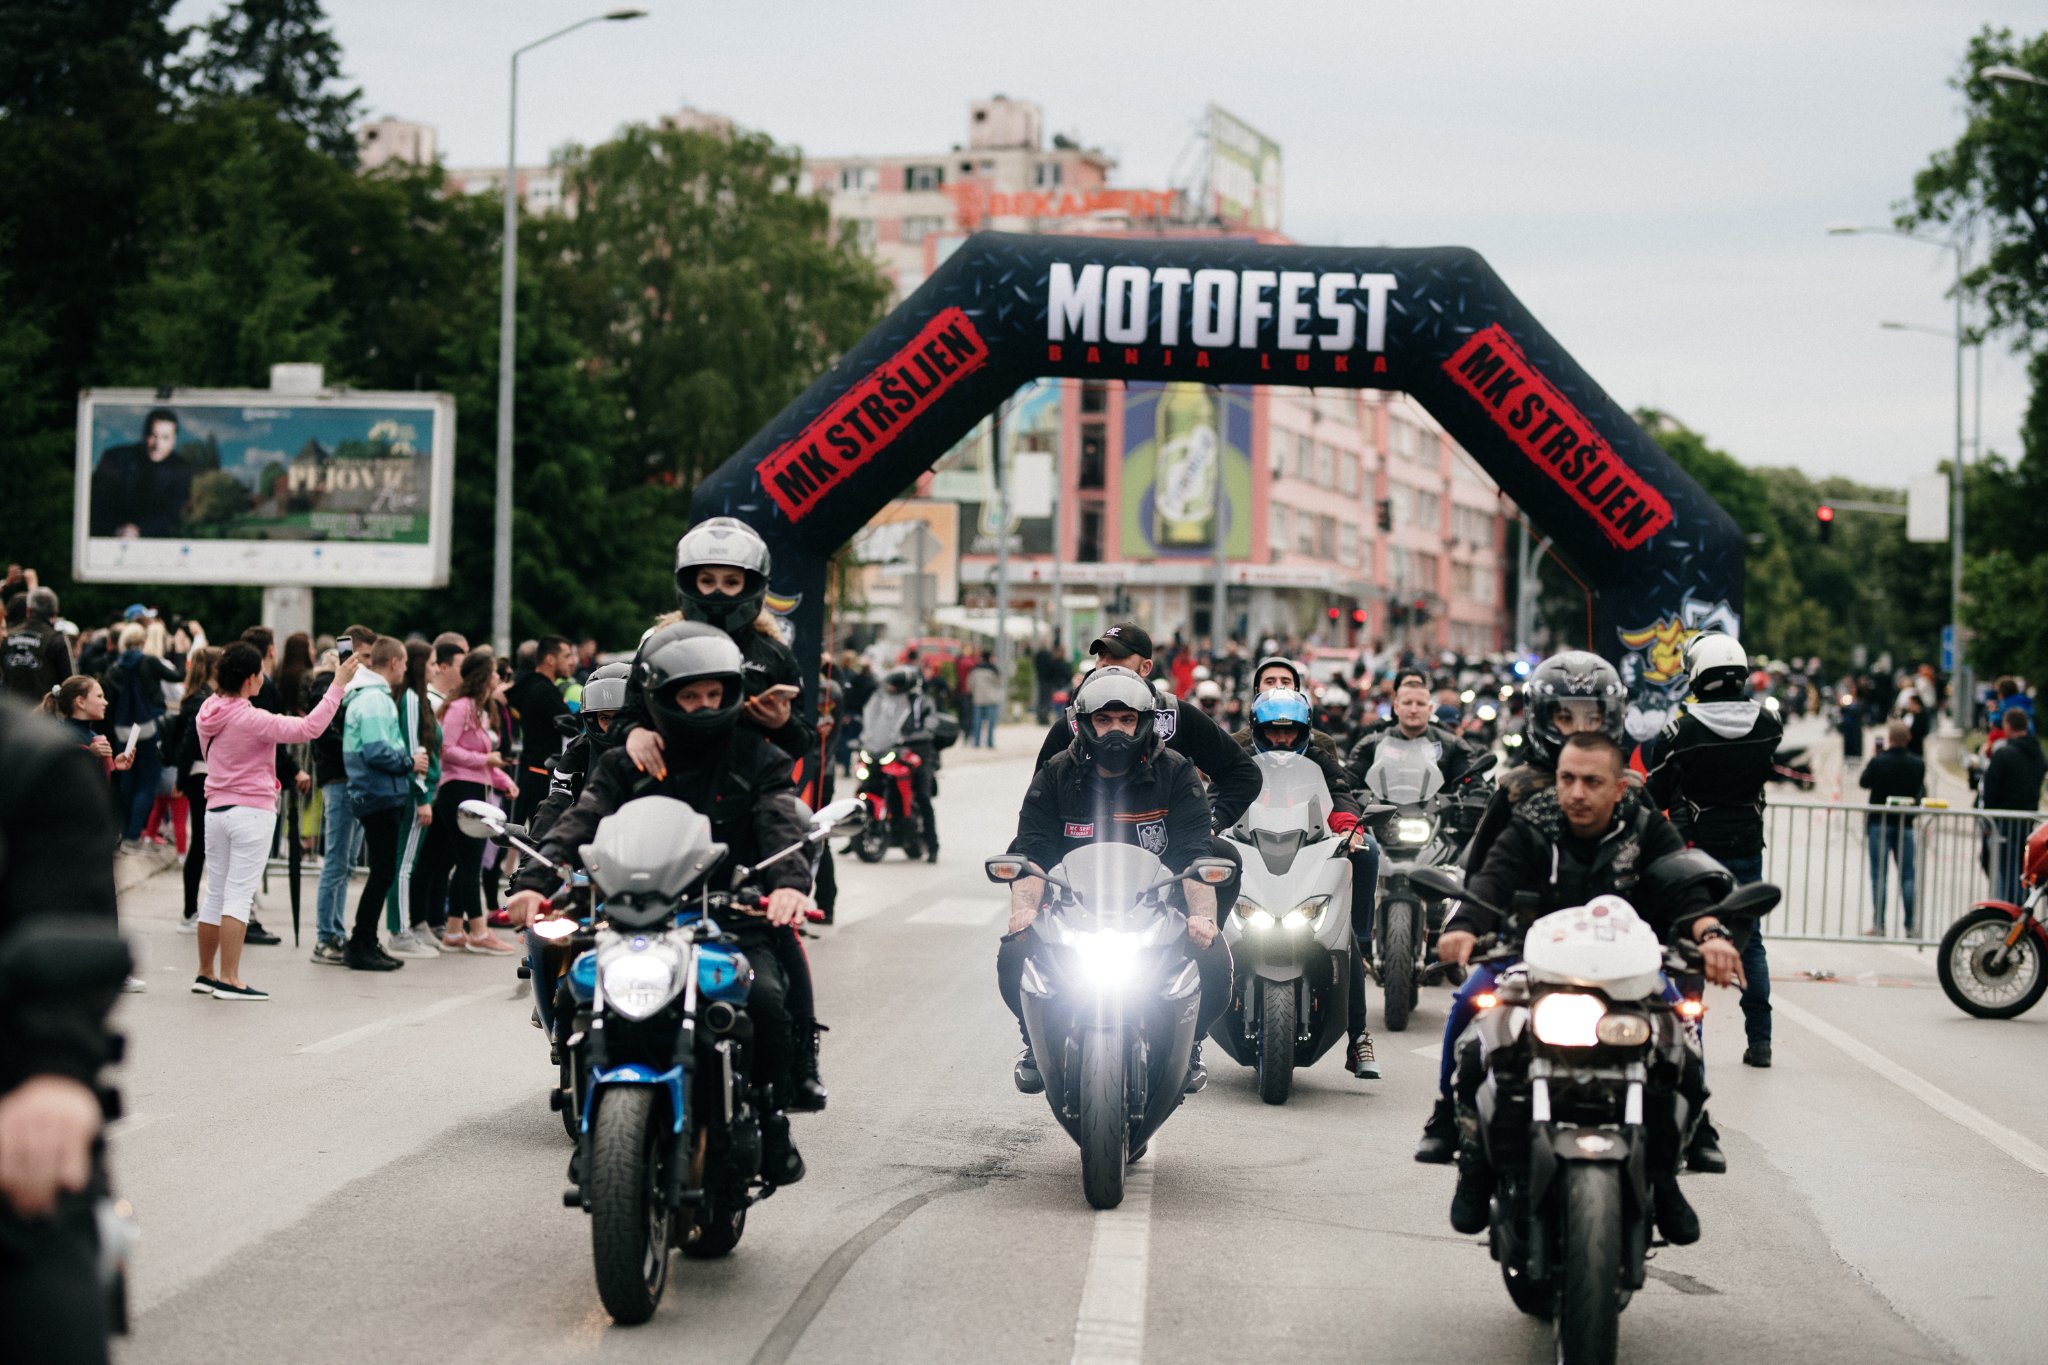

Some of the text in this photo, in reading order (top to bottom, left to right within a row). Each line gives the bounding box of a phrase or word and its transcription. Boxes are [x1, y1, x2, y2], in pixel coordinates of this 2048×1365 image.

[1047, 262, 1399, 352] MOTOFEST
[1049, 344, 1388, 373] BANJA LUKA
[773, 323, 978, 507] MK STRŠLJEN
[1458, 343, 1655, 539] MK STRŠLJEN
